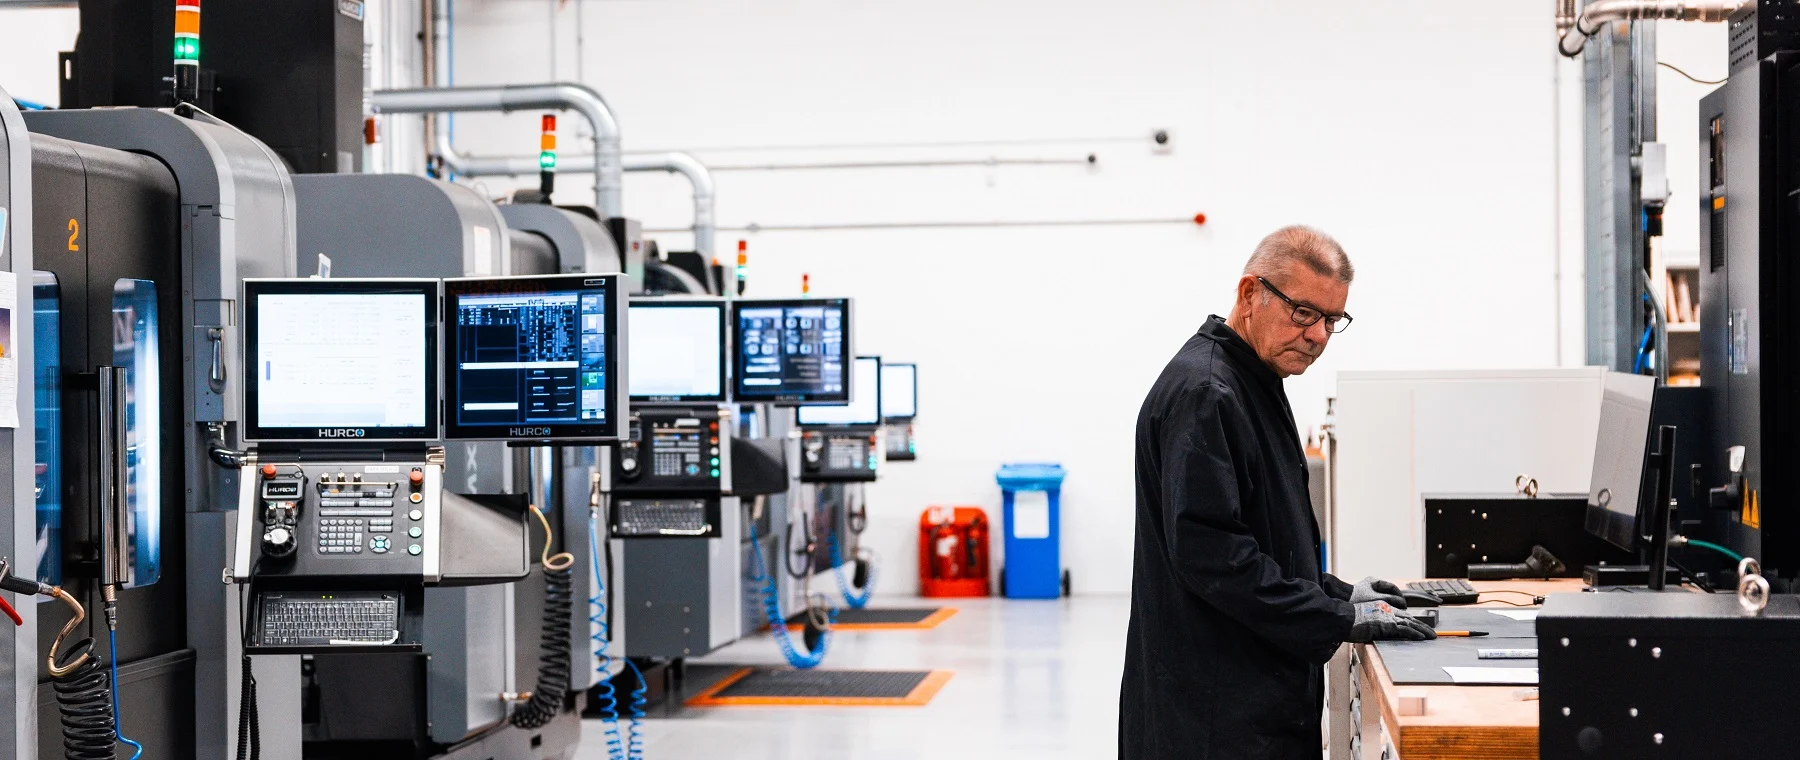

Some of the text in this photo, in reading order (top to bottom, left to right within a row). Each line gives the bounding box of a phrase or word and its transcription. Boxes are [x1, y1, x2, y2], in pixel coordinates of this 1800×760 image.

[68, 218, 79, 251] 2
[318, 428, 365, 438] HURCO
[509, 427, 551, 436] HURCO
